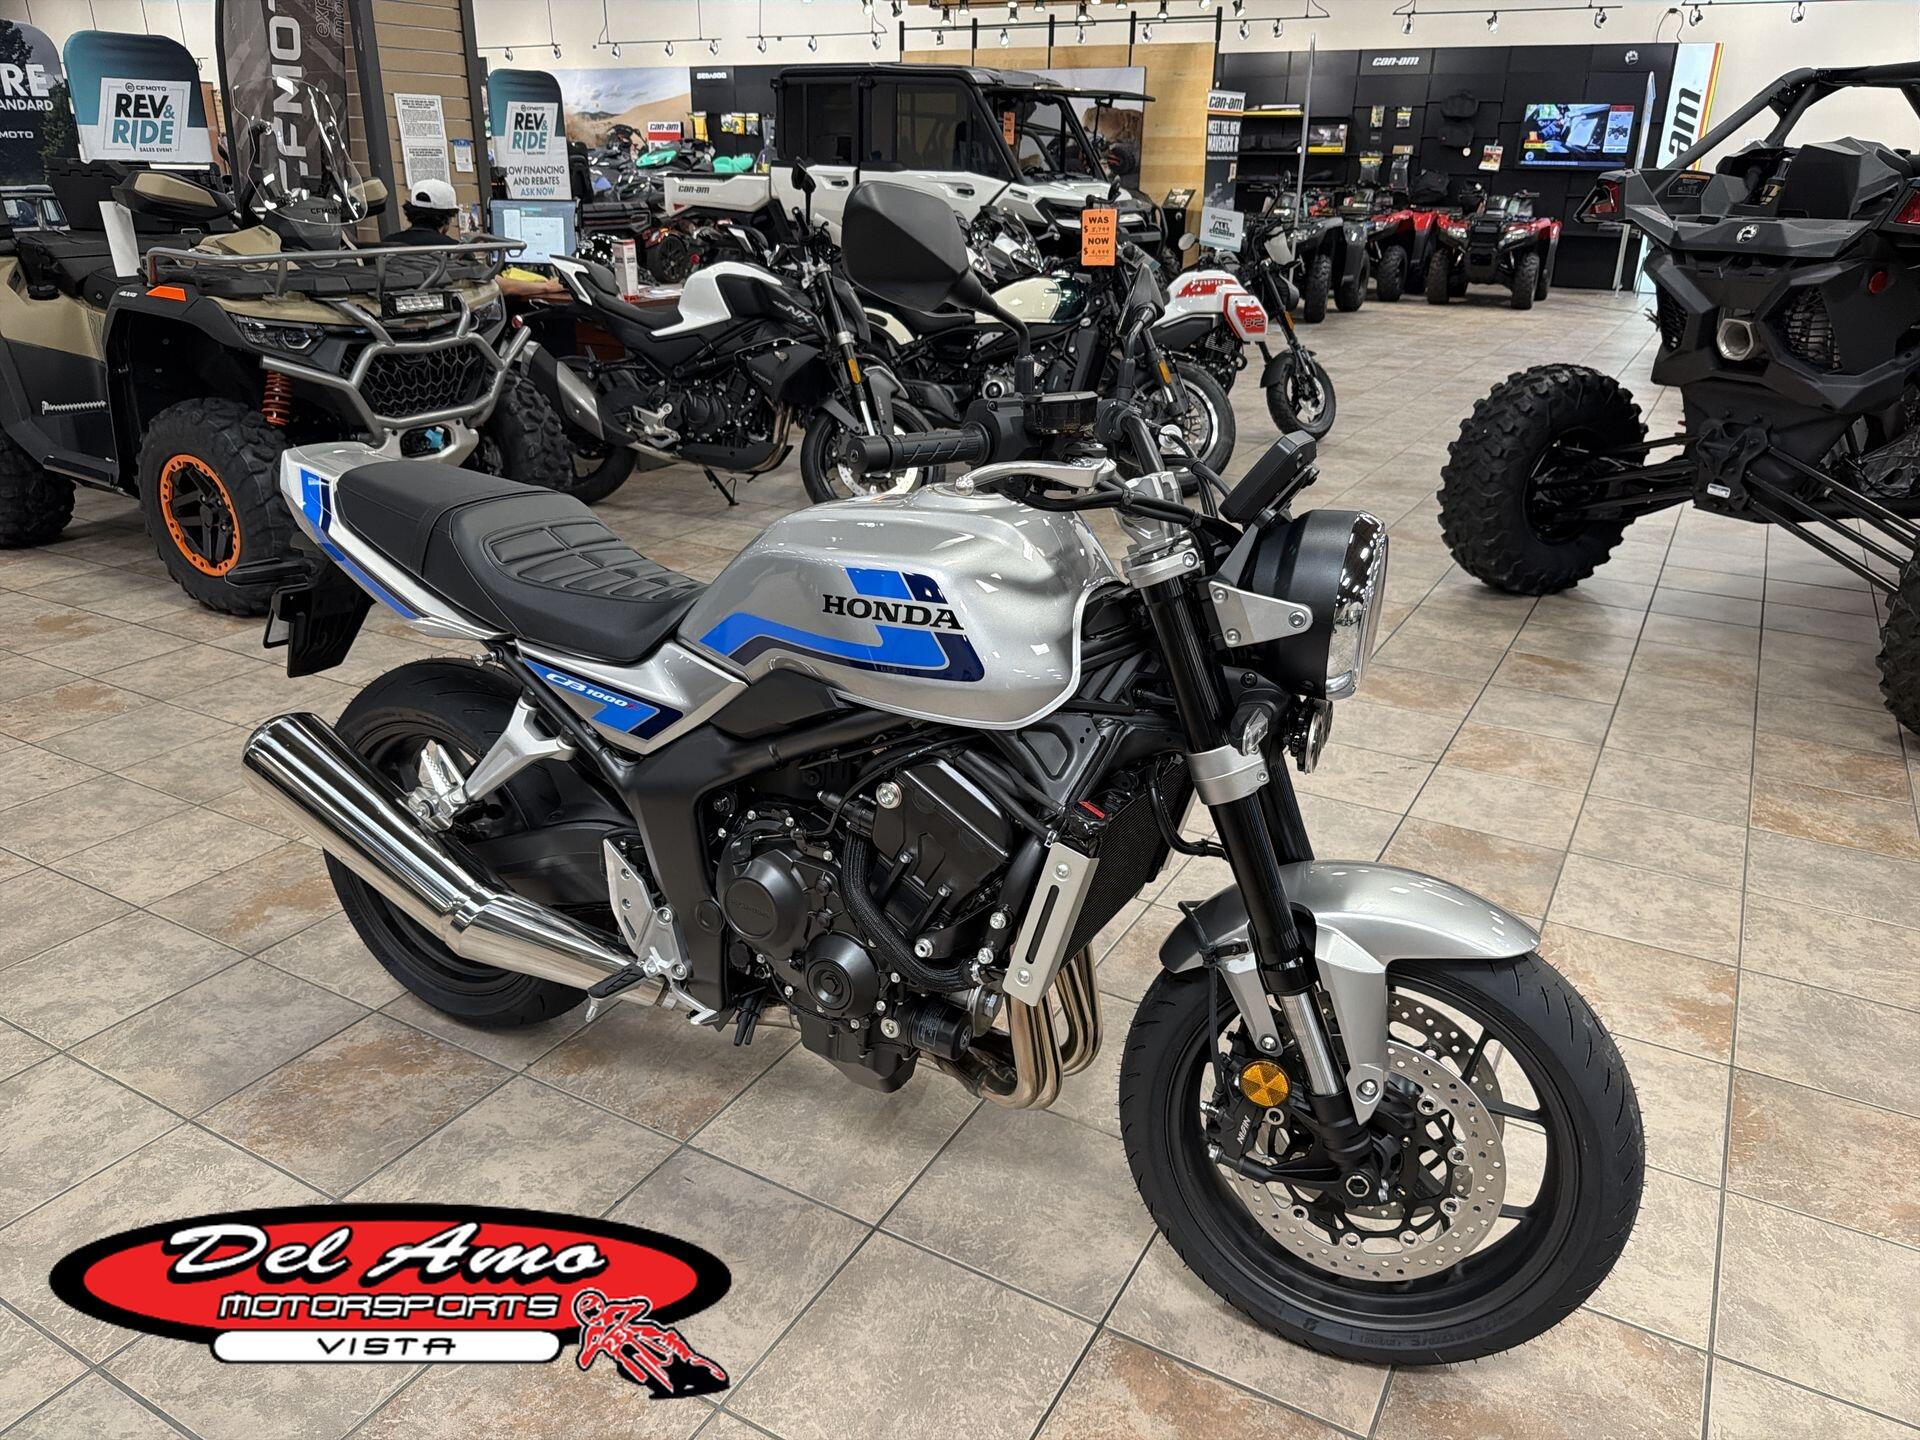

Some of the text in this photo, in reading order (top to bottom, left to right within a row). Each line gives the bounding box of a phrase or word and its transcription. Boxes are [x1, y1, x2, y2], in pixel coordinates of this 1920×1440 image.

[1372, 57, 1420, 67] can-am
[1209, 96, 1244, 110] can-am
[649, 123, 680, 132] can-am
[112, 119, 174, 152] RIDE
[512, 131, 548, 155] RIDE
[523, 165, 565, 175] FINANCING
[513, 176, 560, 186] AND REBATES
[520, 187, 555, 196] ASK NOW
[678, 185, 711, 195] can-am
[1088, 216, 1110, 224] WAS
[1083, 225, 1089, 233] $
[1087, 237, 1110, 245] NOW
[1083, 247, 1089, 255] $
[822, 594, 964, 630] HONDA
